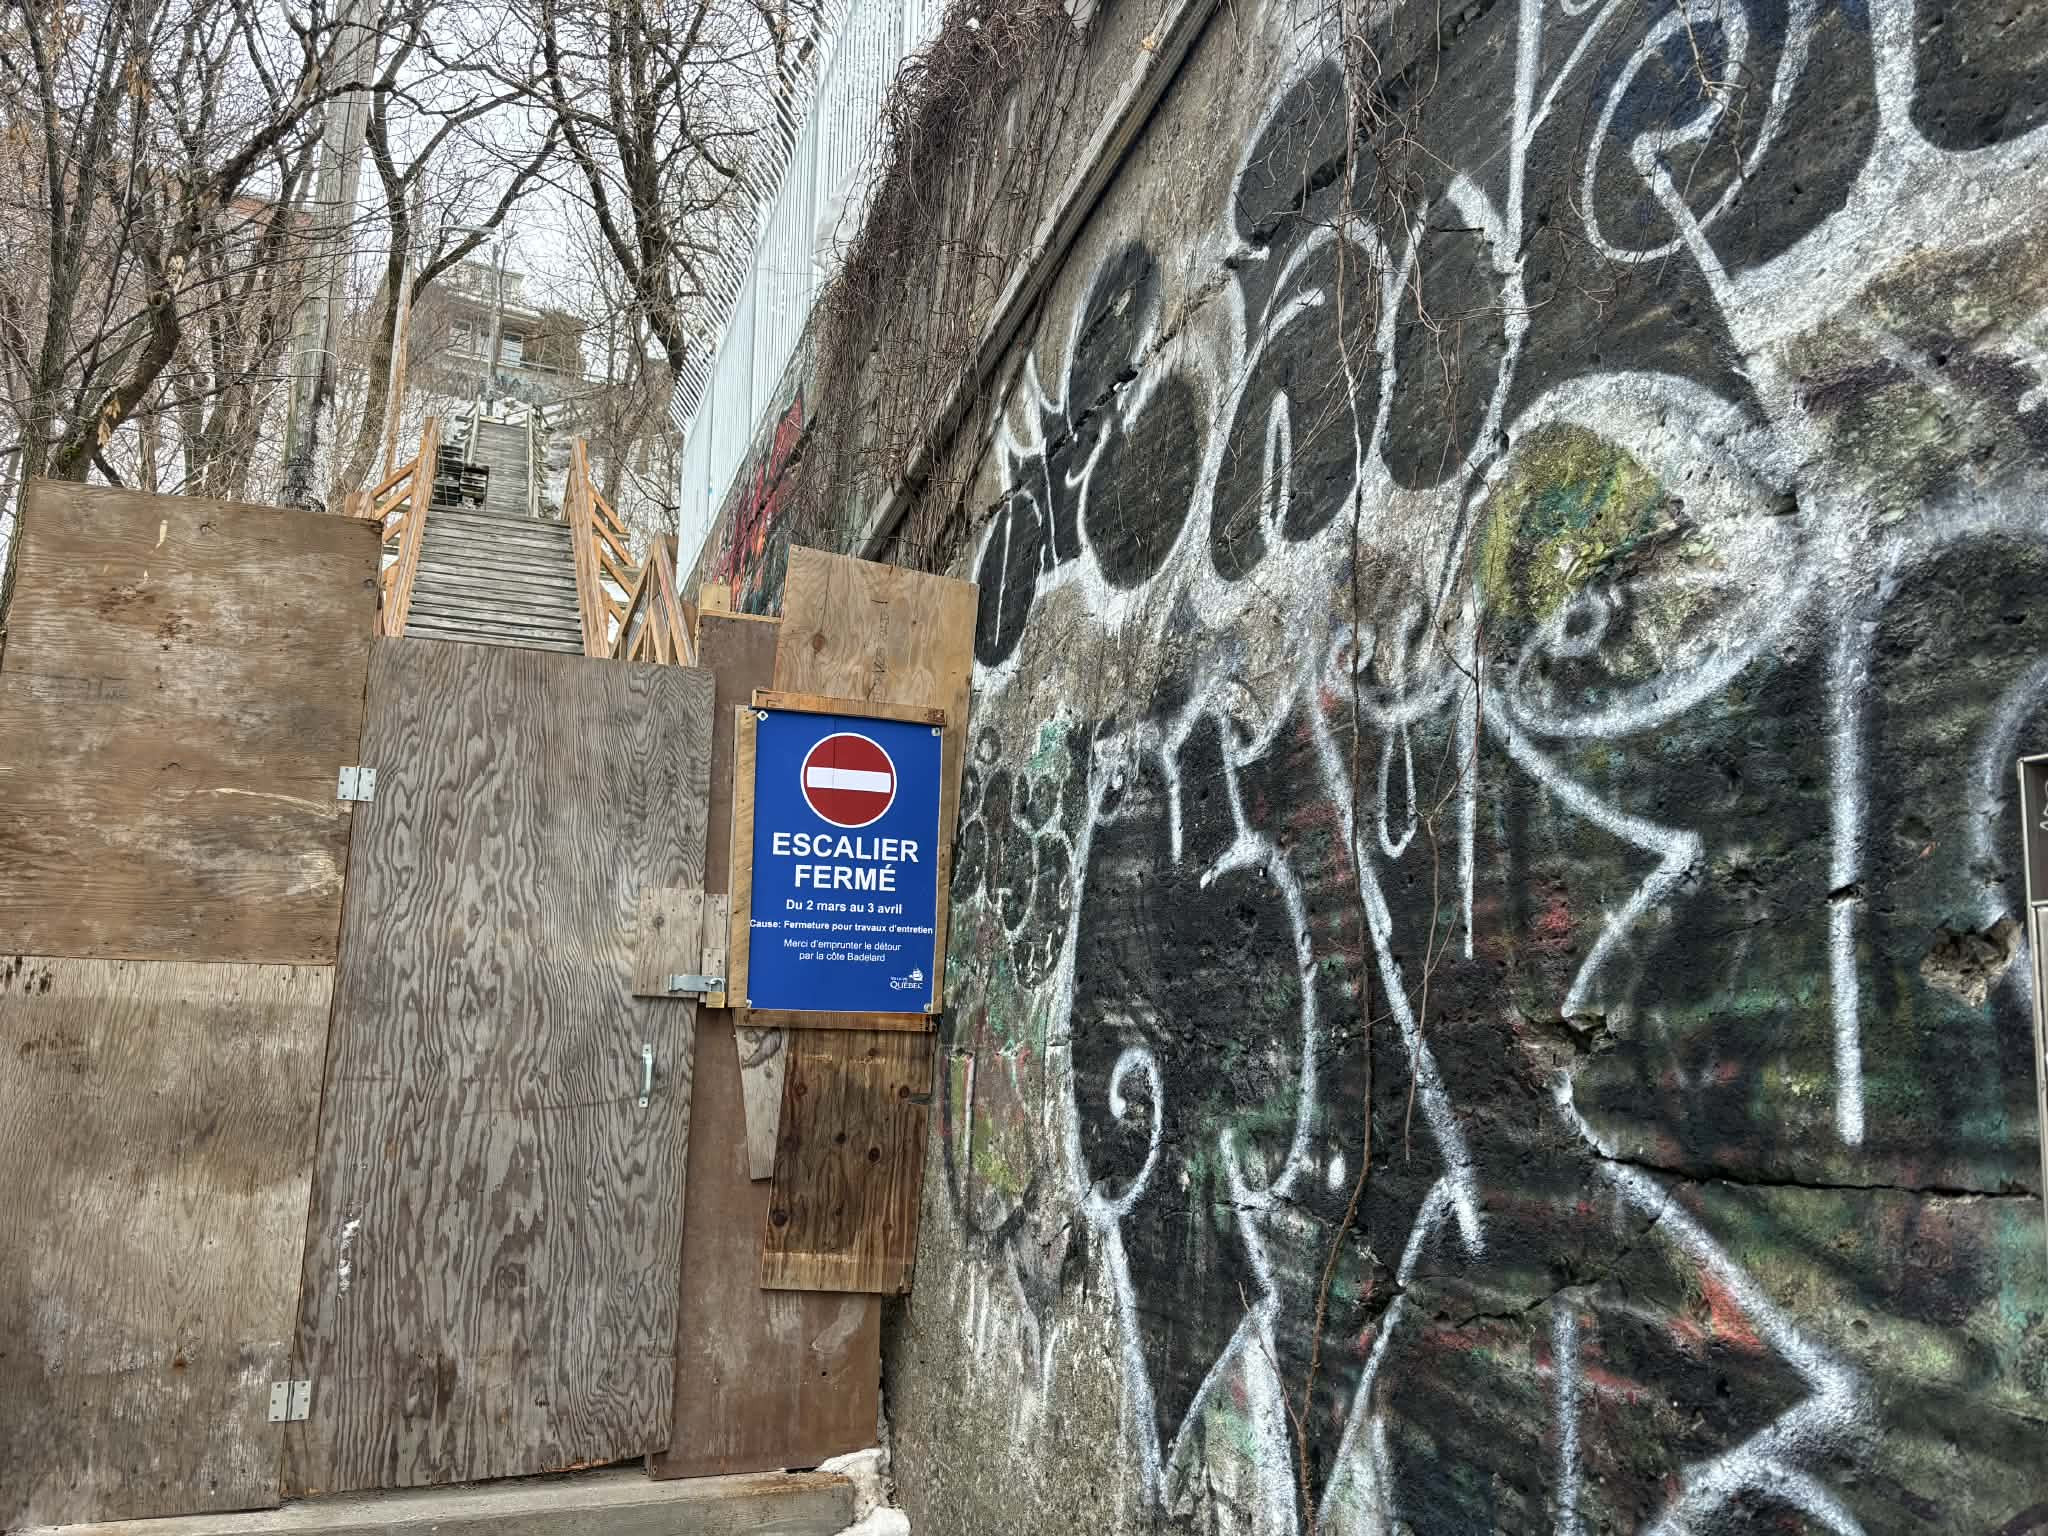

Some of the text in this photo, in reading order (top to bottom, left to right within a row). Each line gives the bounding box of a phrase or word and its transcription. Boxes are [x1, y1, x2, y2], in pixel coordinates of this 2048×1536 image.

[772, 832, 918, 863] ESCALIER
[795, 864, 896, 892] FERMÉ
[786, 899, 902, 914] Du 2 mars au 3 avril
[749, 919, 933, 935] Cause: Fermeture pour travaux d'entretien
[784, 939, 902, 951] Merci d'emprunter le détour
[799, 951, 886, 963] par la côte Badelard
